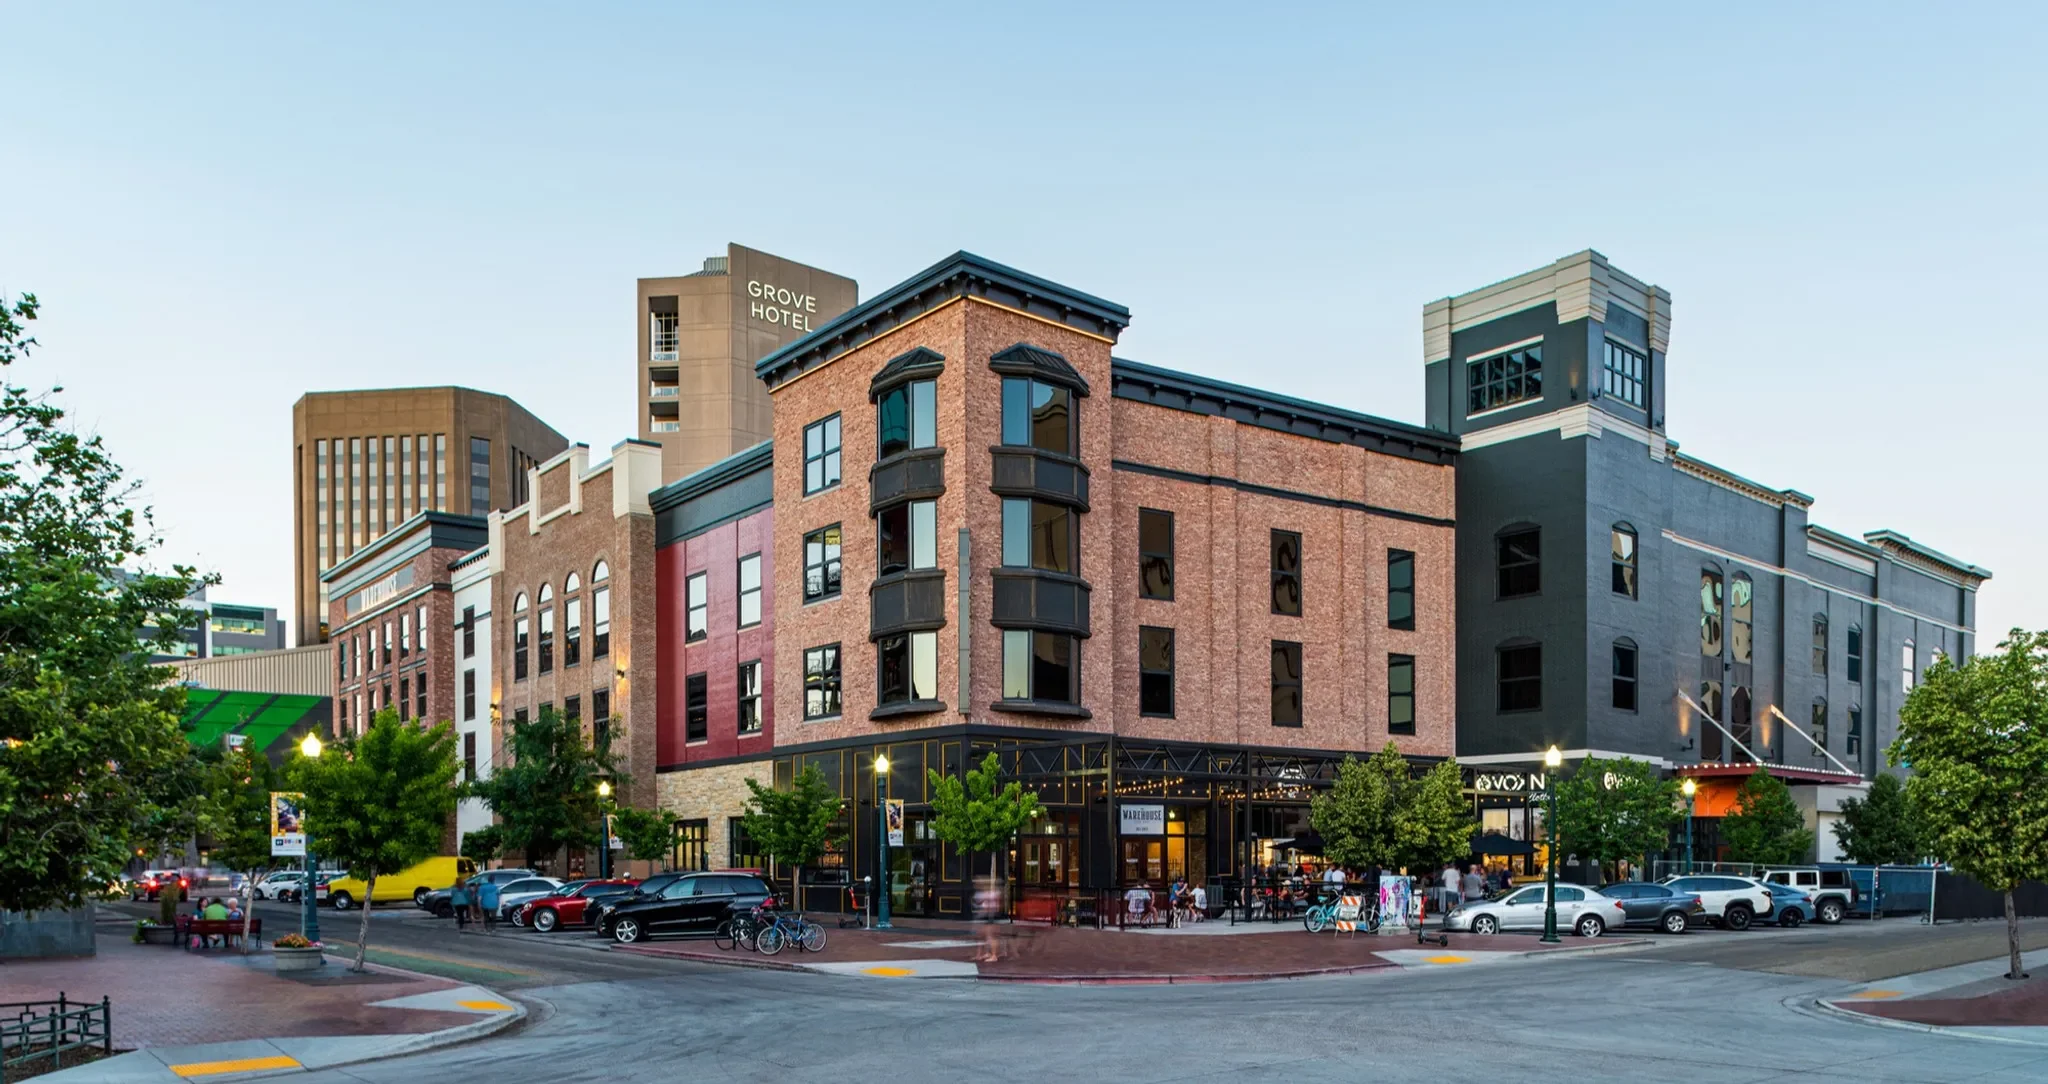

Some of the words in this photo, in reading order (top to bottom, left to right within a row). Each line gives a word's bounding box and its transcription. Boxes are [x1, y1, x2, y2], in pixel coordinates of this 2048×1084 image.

[747, 280, 817, 313] GROVE
[751, 301, 814, 333] HOTEL
[1123, 810, 1161, 820] WAREHOUSE
